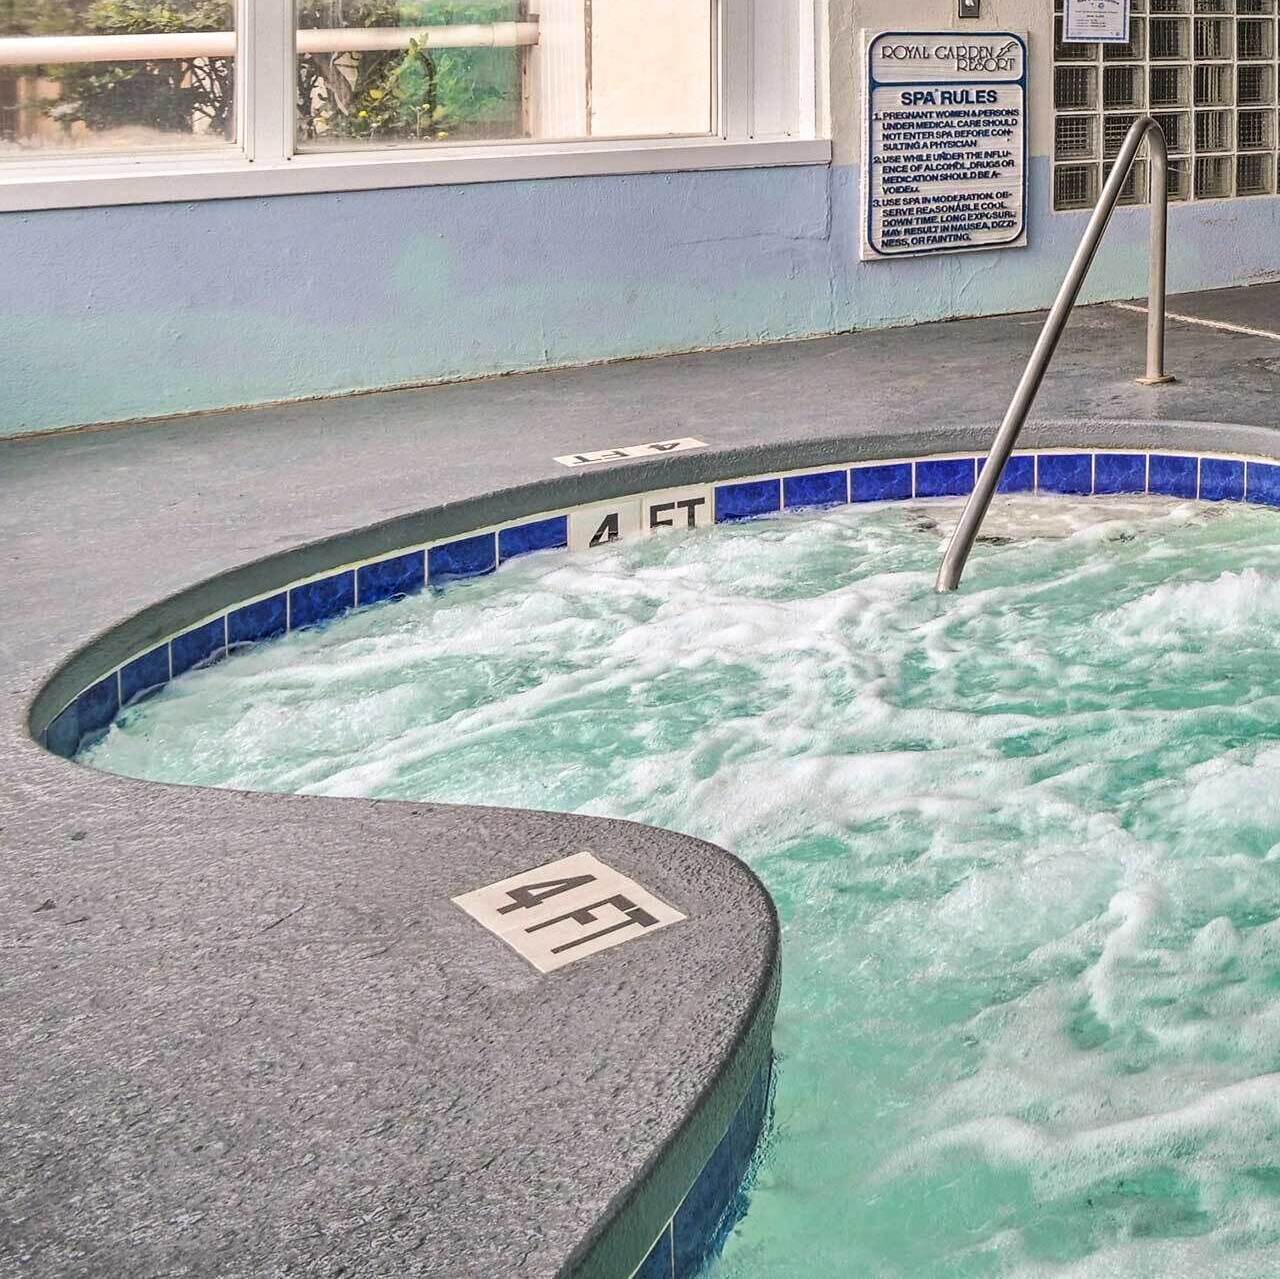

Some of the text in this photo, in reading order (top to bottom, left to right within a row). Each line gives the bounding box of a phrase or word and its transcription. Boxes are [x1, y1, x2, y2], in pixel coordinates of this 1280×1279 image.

[882, 45, 994, 59] ROYAL GARDEN
[957, 58, 1015, 72] RESORT
[901, 89, 997, 105] SPA RULES
[883, 111, 934, 120] PREGNANT
[936, 110, 970, 118] WOMEN
[978, 109, 1019, 117] PERSONS
[883, 119, 1017, 130] UNDER MEDICAL CARE SHOULD
[882, 132, 902, 141] NOT
[903, 132, 934, 140] ENTER
[936, 131, 953, 139] SPA
[955, 130, 990, 138] BEFORE
[883, 140, 977, 151] SULTING A PHYSICIAN
[883, 156, 900, 164] USE
[903, 154, 932, 163] WHILE
[933, 153, 964, 161] UNDER
[965, 152, 983, 160] THE
[883, 165, 908, 174] ENCE
[910, 164, 923, 173] OF
[1001, 160, 1014, 168] OR
[883, 174, 939, 184] MEDICATION
[940, 172, 977, 181] SHOULD
[978, 171, 989, 179] BE
[883, 198, 900, 206] USE
[903, 197, 920, 205] SPA
[922, 196, 931, 204] IN
[883, 208, 914, 218] SERVE
[916, 204, 980, 215] REASONABLE
[883, 218, 913, 227] DOWN
[941, 214, 966, 222] LONG
[882, 228, 902, 238] MAY
[904, 226, 938, 236] RESULT
[940, 224, 949, 232] IN
[951, 222, 990, 232] NAUSEA,
[881, 238, 910, 248] NESS,
[911, 236, 926, 245] OR
[589, 497, 705, 548] 4 FT
[496, 874, 661, 955] 4 FT
